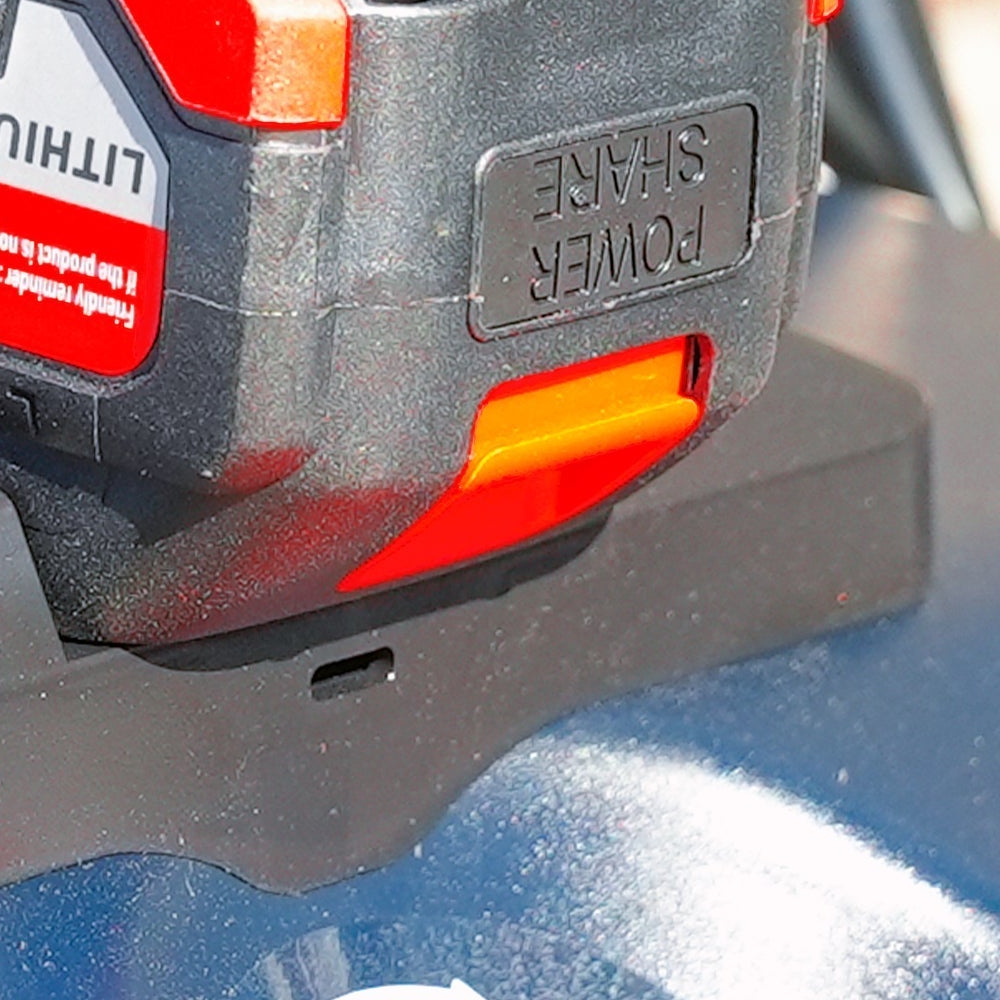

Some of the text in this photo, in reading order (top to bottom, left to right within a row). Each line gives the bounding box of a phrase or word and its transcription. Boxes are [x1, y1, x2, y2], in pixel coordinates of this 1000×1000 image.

[532, 124, 709, 224] SHARE
[21, 238, 35, 265] is
[38, 243, 97, 277] product
[529, 205, 704, 305] POWER
[98, 263, 123, 291] the
[125, 270, 138, 295] if
[75, 284, 135, 329] Friendly
